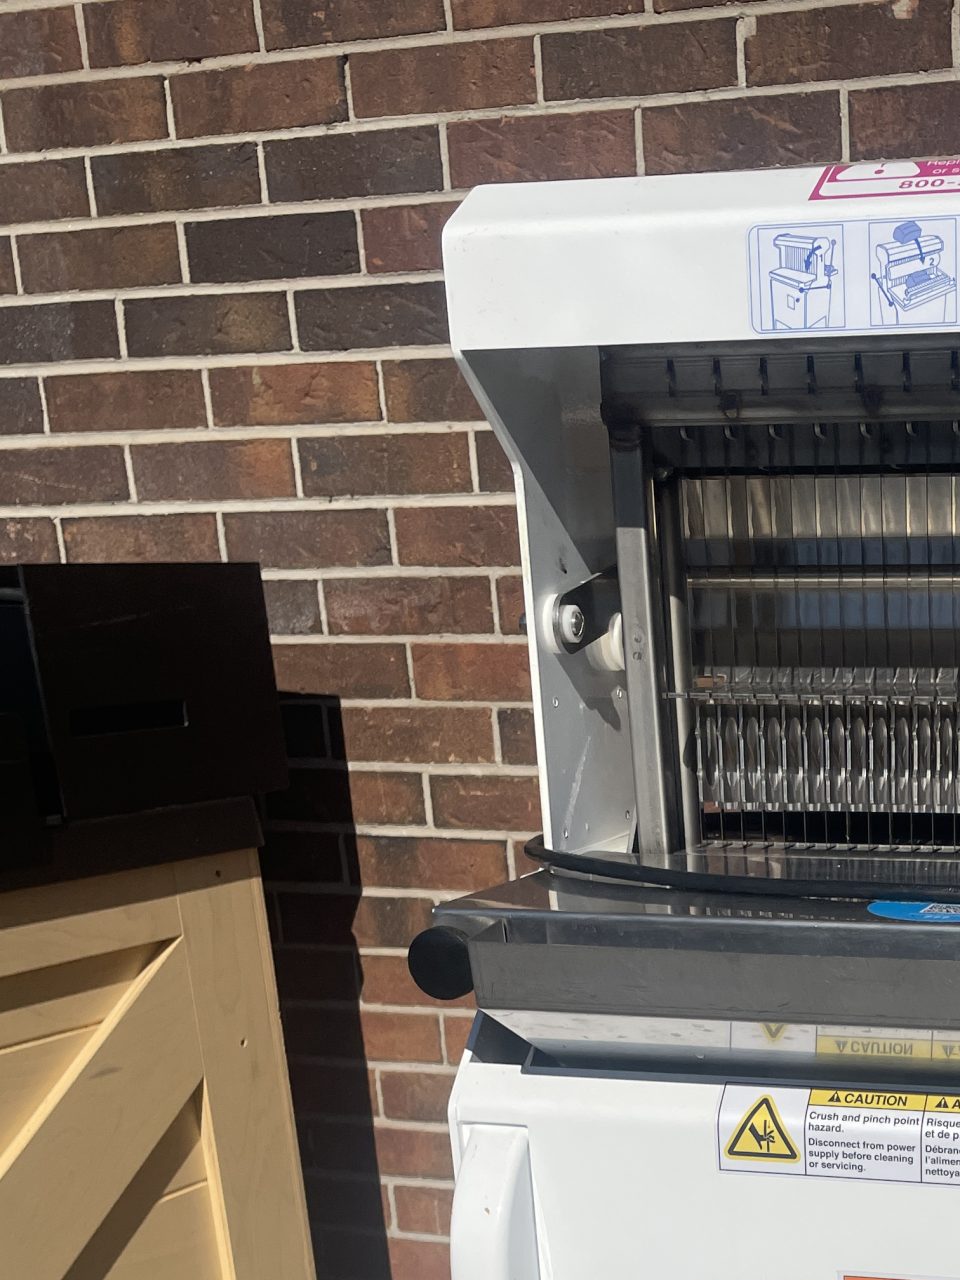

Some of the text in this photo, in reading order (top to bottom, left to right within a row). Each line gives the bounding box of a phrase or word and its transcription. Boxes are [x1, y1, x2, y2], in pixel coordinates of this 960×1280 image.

[928, 256, 935, 267] 2
[844, 1092, 908, 1107] CAUTION
[809, 1111, 921, 1127] Crush and pinch point
[926, 1118, 960, 1130] Risque
[924, 1129, 935, 1138] et
[937, 1130, 950, 1139] de
[808, 1138, 916, 1154] Disconnect from power
[808, 1149, 913, 1165] supply before cleaning
